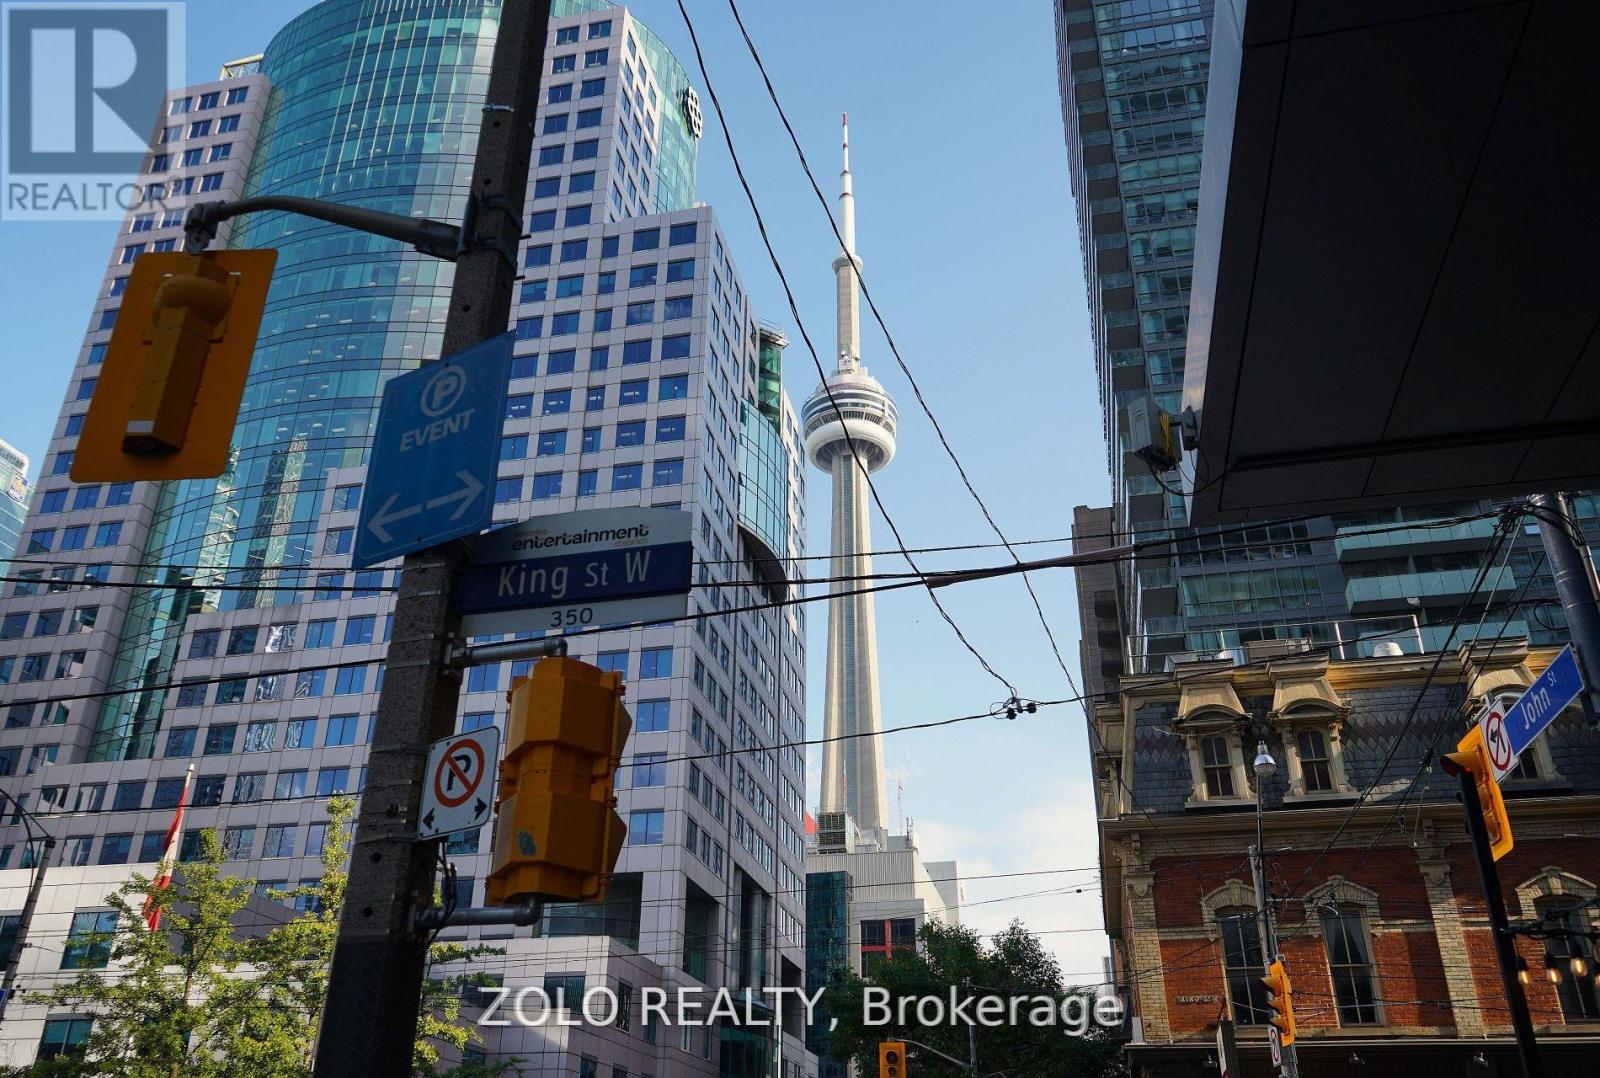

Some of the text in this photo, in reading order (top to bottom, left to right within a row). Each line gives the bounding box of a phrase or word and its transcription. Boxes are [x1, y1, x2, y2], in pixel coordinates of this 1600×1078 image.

[400, 408, 475, 453] EVENT
[512, 523, 650, 551] entertainment
[498, 550, 651, 599] King St W
[551, 607, 593, 627] 350
[1520, 687, 1551, 730] John
